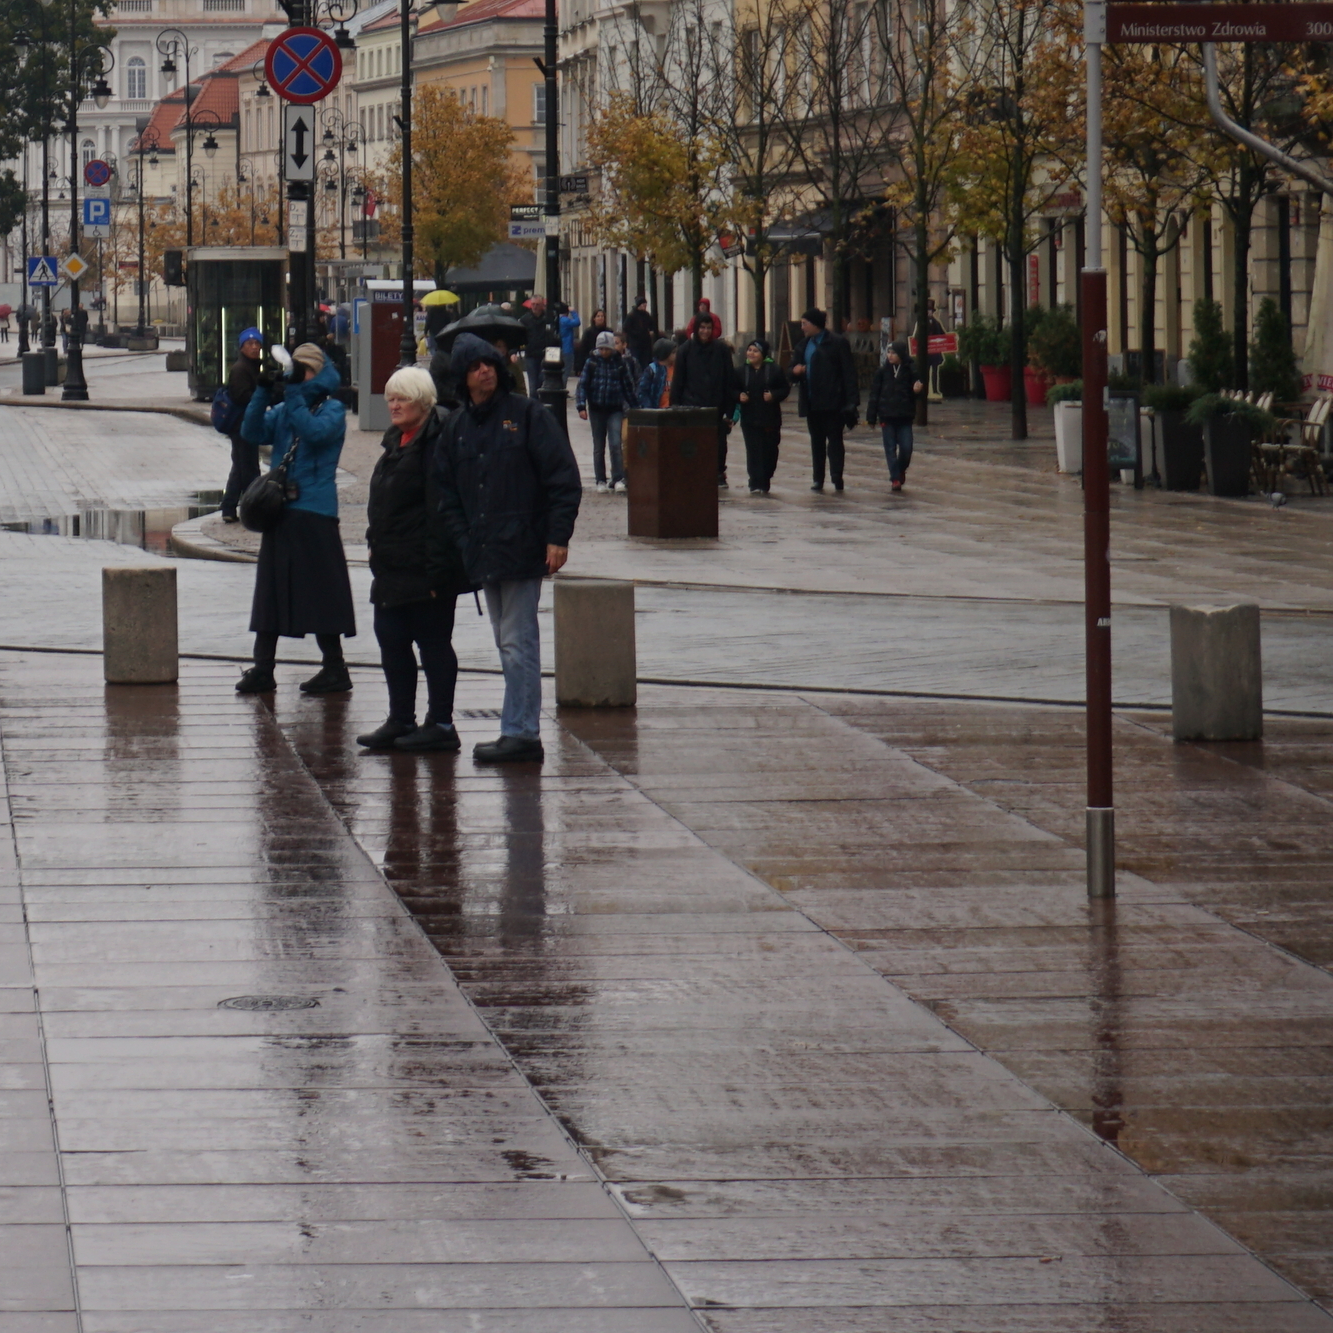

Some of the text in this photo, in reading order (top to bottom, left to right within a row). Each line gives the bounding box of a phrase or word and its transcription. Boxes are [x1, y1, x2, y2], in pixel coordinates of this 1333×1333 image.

[1121, 21, 1266, 37] Ministerstwo Zdrowia
[1306, 21, 1333, 36] 300
[90, 201, 105, 222] P
[523, 227, 545, 235] prem
[375, 291, 403, 299] BILETY
